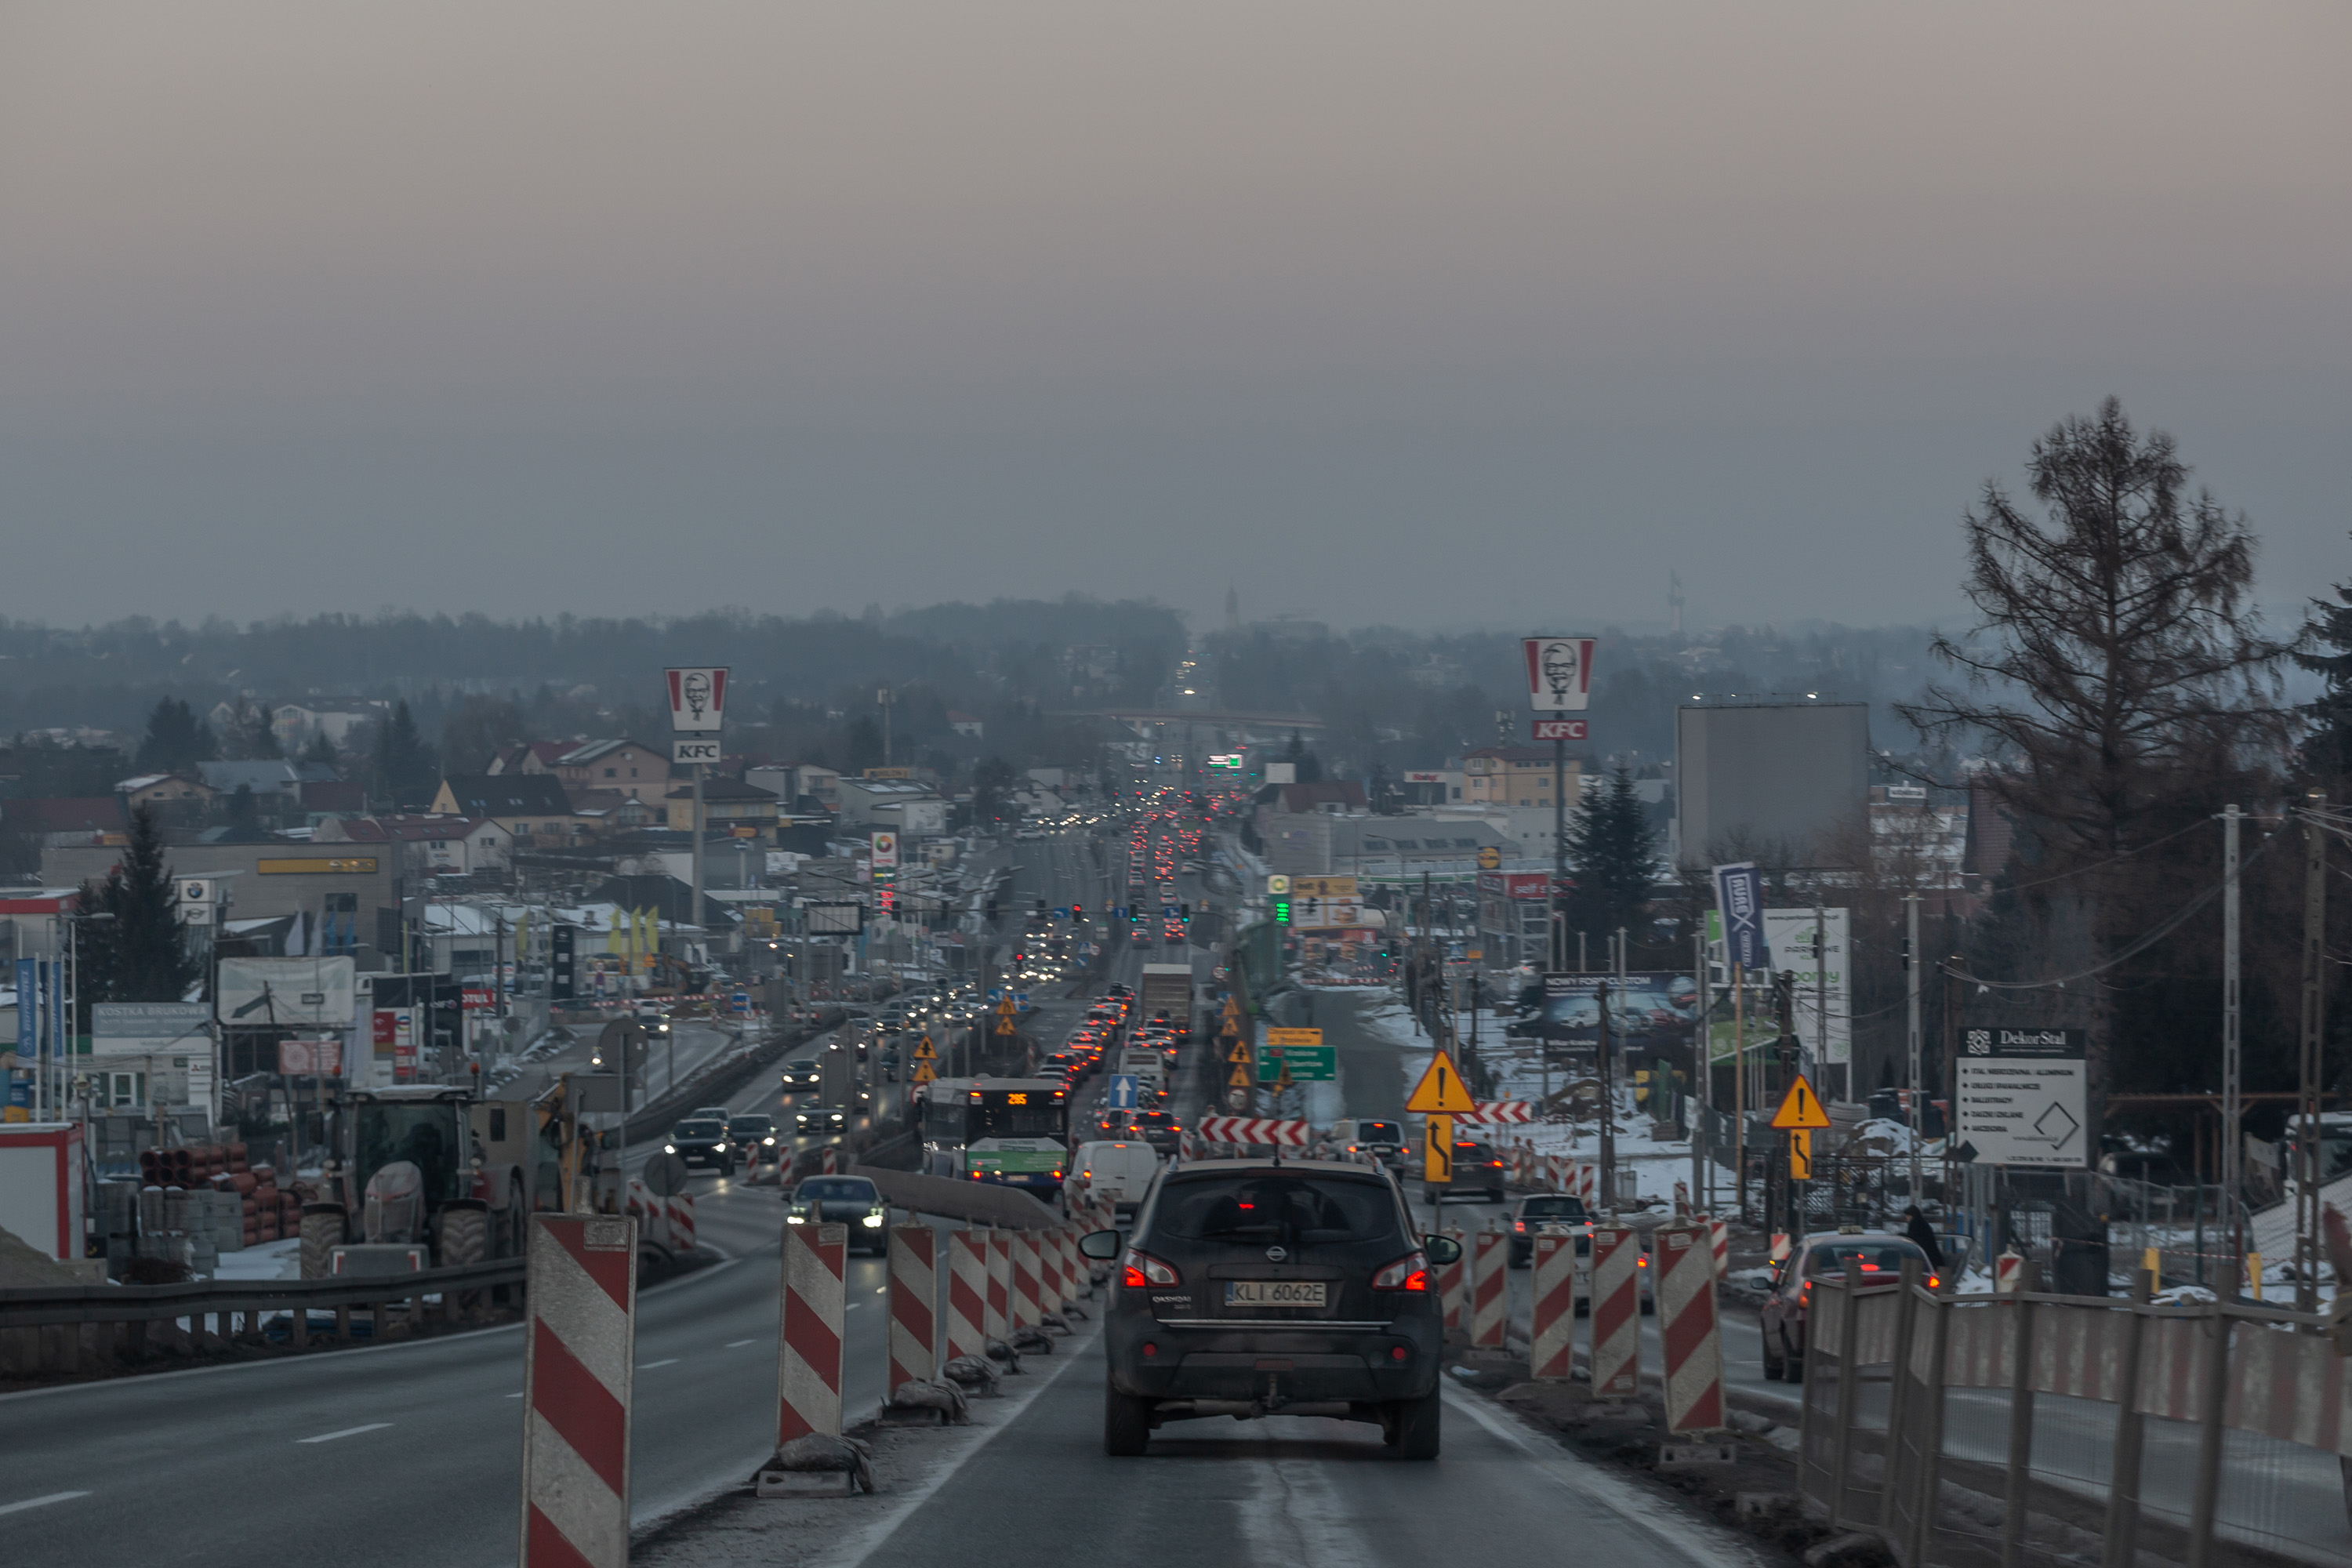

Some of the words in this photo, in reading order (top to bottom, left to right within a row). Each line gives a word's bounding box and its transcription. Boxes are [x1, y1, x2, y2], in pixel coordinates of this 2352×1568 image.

[1536, 722, 1584, 738] KFC
[677, 745, 717, 758] KFC
[1515, 883, 1537, 894] self
[1544, 977, 1577, 985] NOWY
[98, 1007, 143, 1016] KOSTKA
[147, 1007, 207, 1015] BRUKOWA
[1234, 1283, 1264, 1301] KLI
[1272, 1284, 1323, 1301] 6062E
